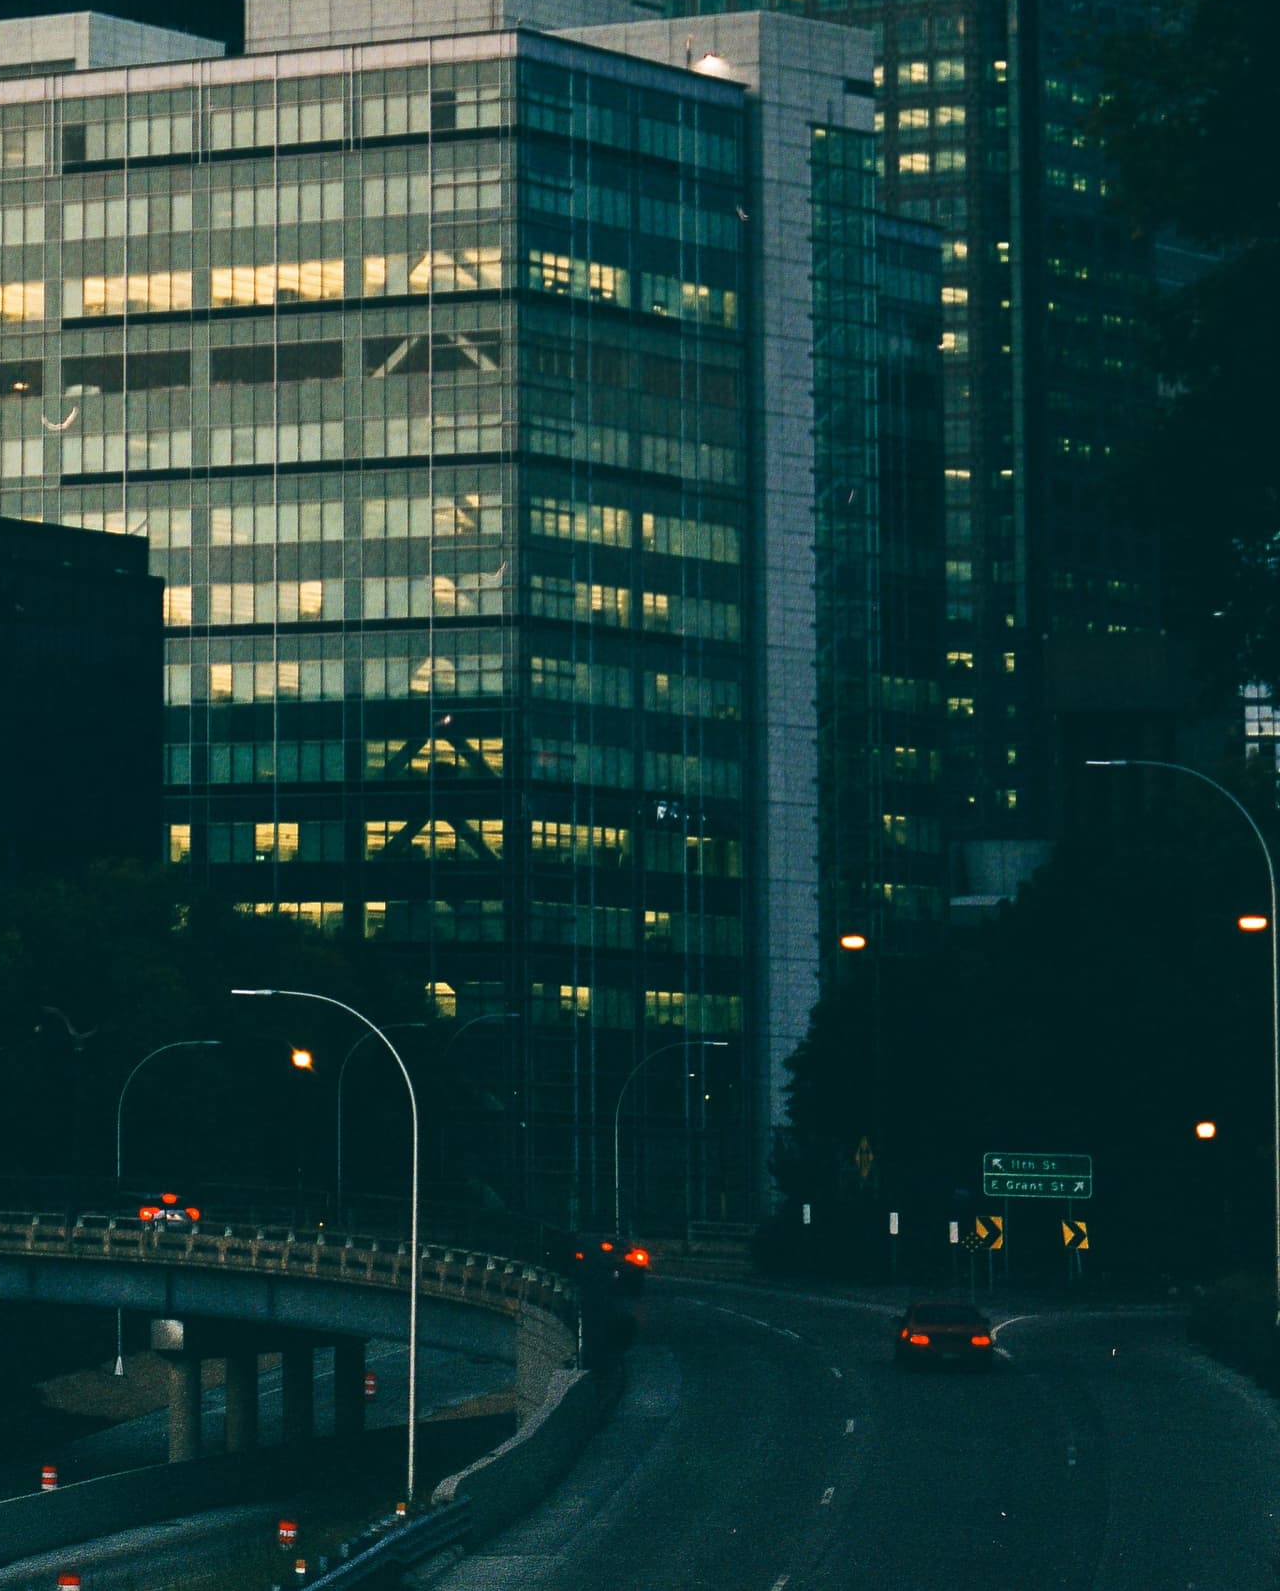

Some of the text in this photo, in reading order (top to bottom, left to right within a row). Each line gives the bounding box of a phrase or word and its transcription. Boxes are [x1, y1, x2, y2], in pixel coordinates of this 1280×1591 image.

[1011, 1159, 1057, 1170] 11th St
[991, 1180, 1065, 1192] E Grant St
